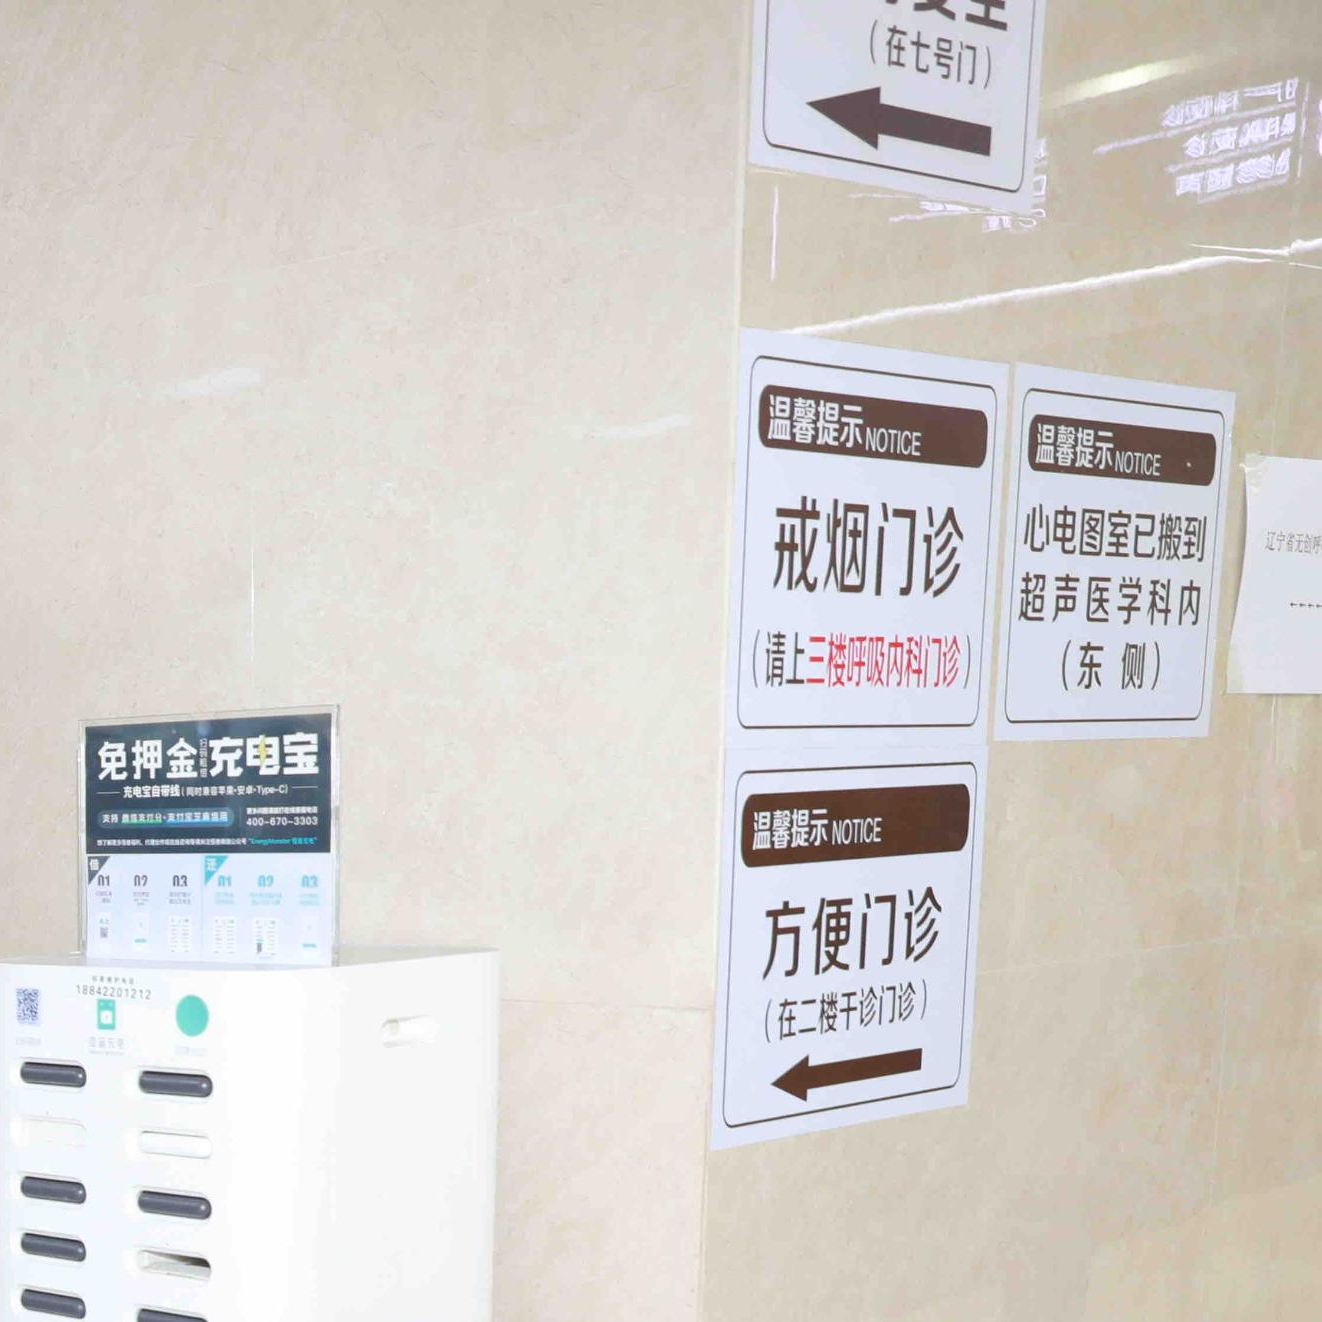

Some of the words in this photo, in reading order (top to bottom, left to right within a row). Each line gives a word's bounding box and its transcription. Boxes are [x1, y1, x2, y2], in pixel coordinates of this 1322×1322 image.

[870, 19, 991, 90] （在七号门）
[768, 394, 864, 447] 温馨提示
[866, 427, 922, 456] NOTICE
[1035, 423, 1115, 470] 温馨提示
[1115, 451, 1161, 476] NOTICE
[773, 495, 965, 598] 戒烟门诊
[1024, 503, 1207, 563] 心电图室已搬到
[1018, 571, 1202, 626] 超声医学科内
[753, 629, 971, 689] （请上三楼呼吸内科门诊）
[97, 737, 198, 781] 免押金
[209, 732, 319, 778] 充电宝
[752, 808, 829, 851] 温馨提示
[831, 817, 882, 846] NOTICE
[762, 886, 942, 981] 方便门诊
[77, 984, 152, 1000] 18842201212
[764, 979, 928, 1043] （在二楼干诊门诊）
